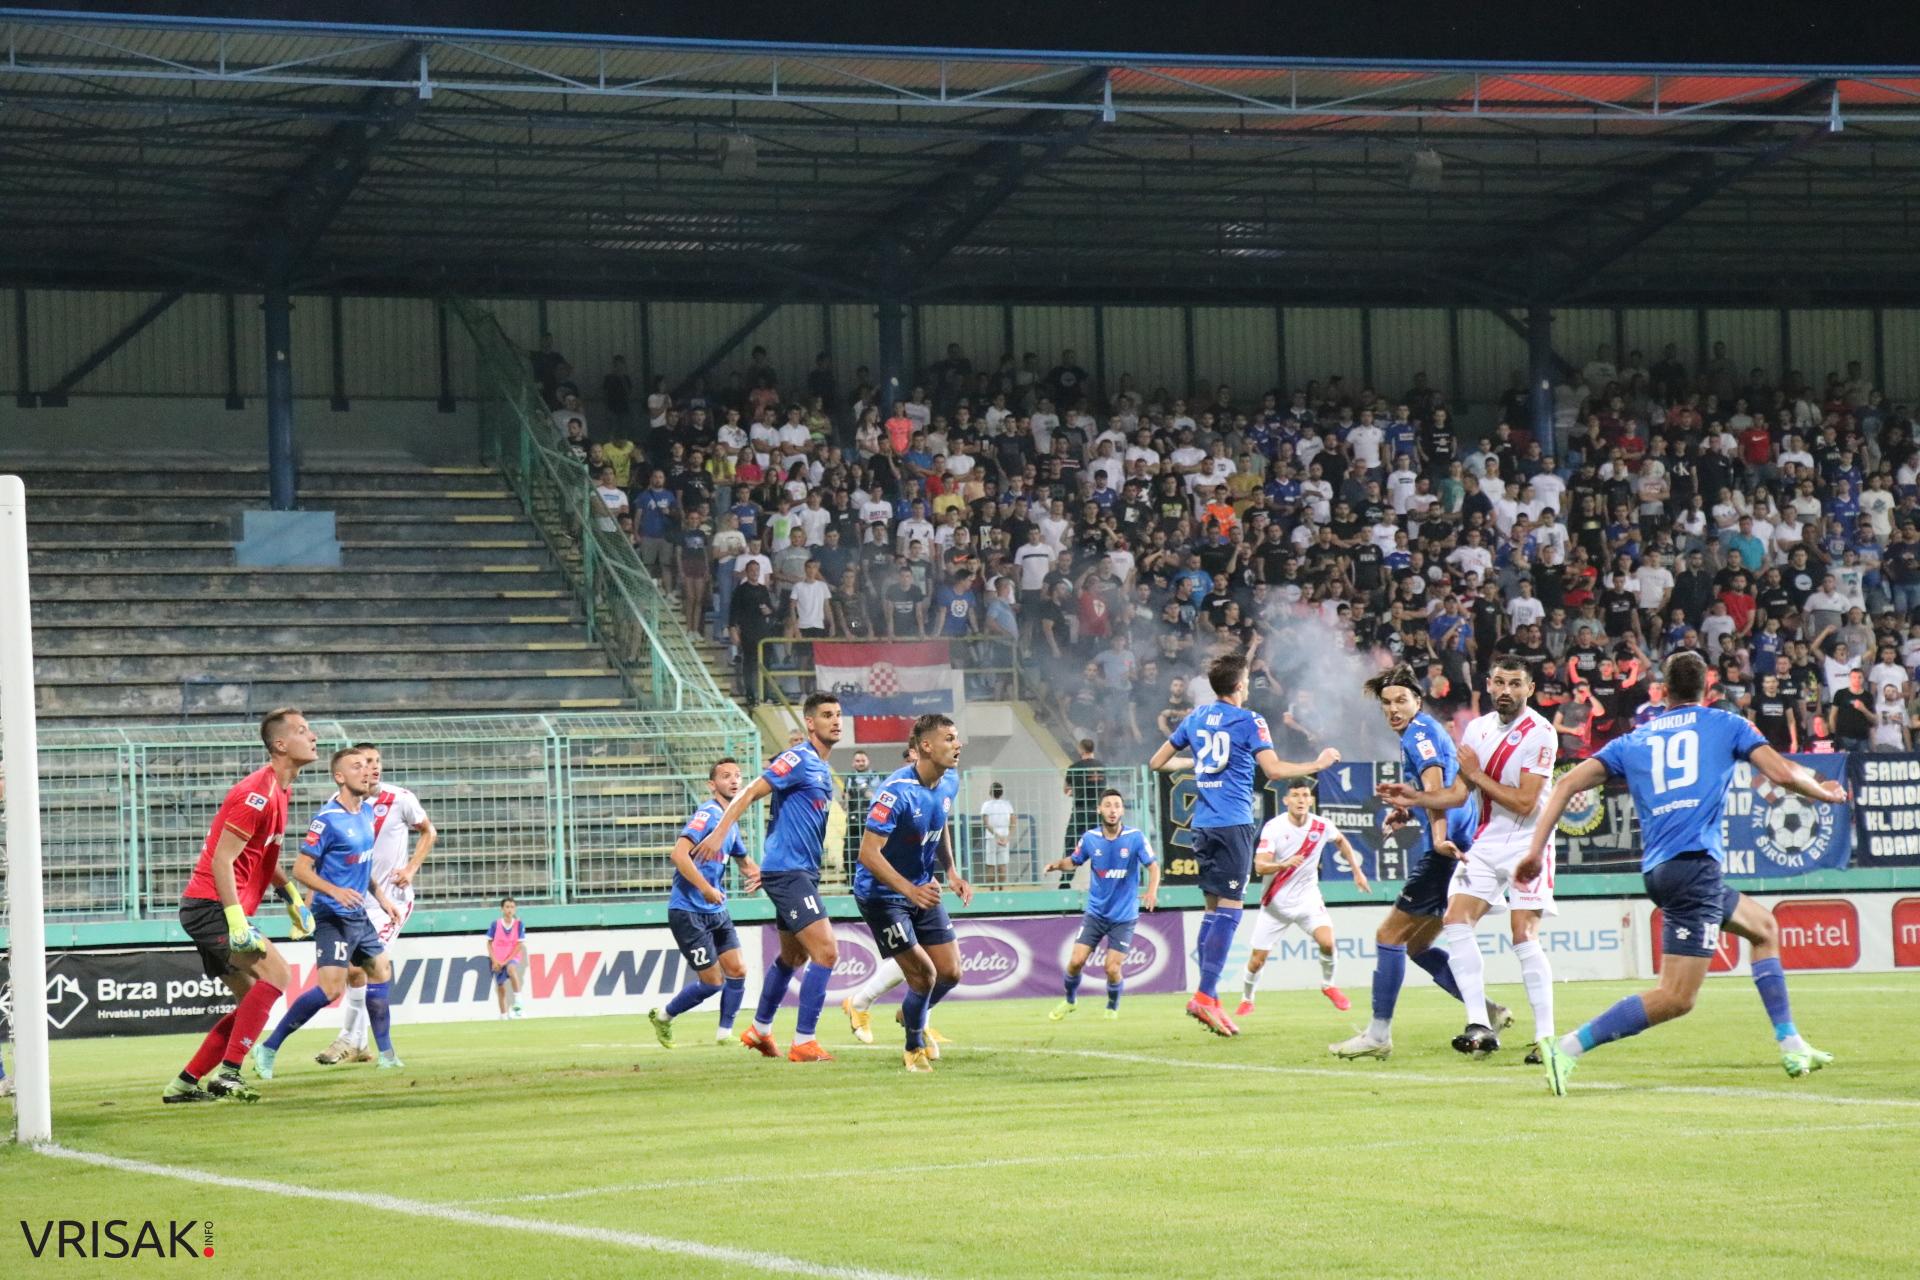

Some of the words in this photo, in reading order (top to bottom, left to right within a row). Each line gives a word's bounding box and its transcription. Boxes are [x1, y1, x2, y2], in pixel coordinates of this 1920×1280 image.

[1650, 711, 1697, 731] VUKOJA
[1195, 730, 1231, 774] 29
[1646, 730, 1699, 794] 19
[1864, 761, 1920, 781] SAMO
[804, 895, 821, 915] 4
[883, 921, 909, 950] 24
[1702, 922, 1720, 950] 19
[1781, 918, 1850, 947] m:tel
[334, 940, 348, 961] 15
[690, 947, 711, 966] 22
[961, 950, 1010, 973] ioleta
[97, 979, 158, 1001] Brza
[98, 1009, 141, 1019] Hrvatska
[142, 1007, 170, 1019] pošta
[172, 1006, 205, 1016] Mostar
